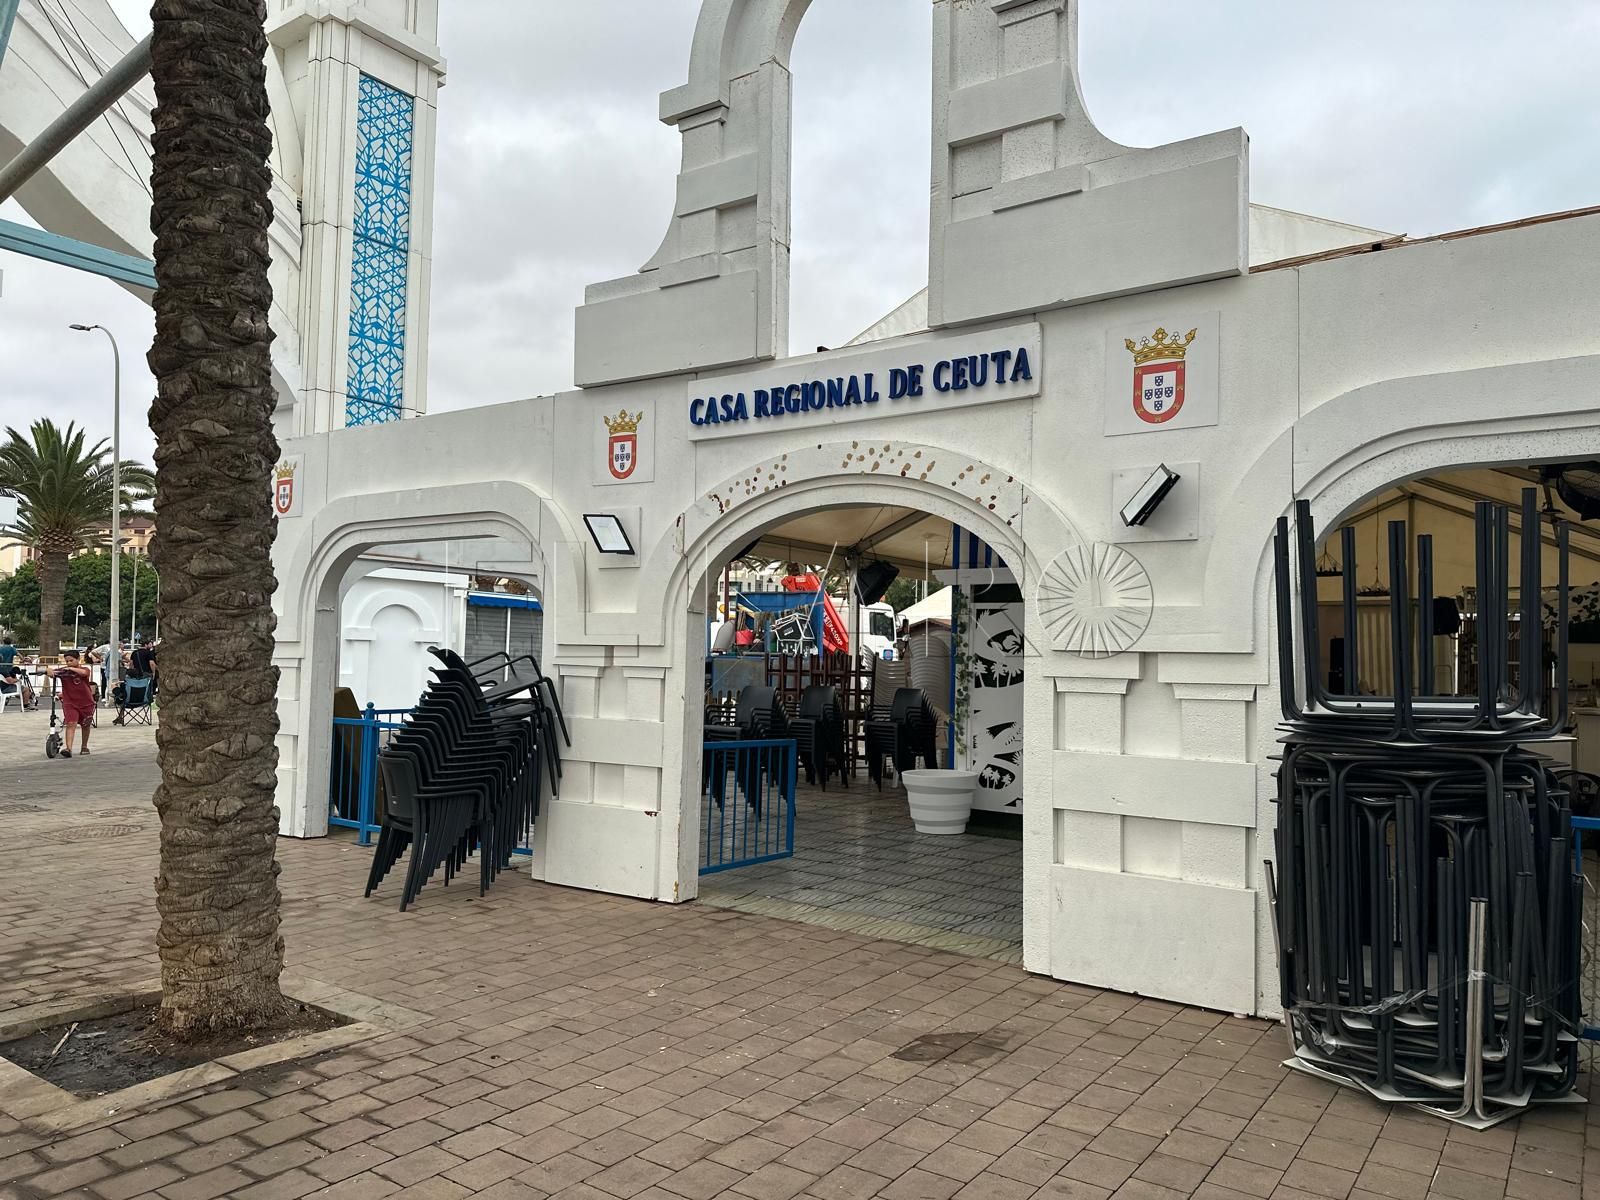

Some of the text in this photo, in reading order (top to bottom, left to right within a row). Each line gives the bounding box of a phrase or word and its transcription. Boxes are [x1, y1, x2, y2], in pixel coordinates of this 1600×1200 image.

[690, 347, 1034, 426] CASA REGIONAL DE CEUTA
